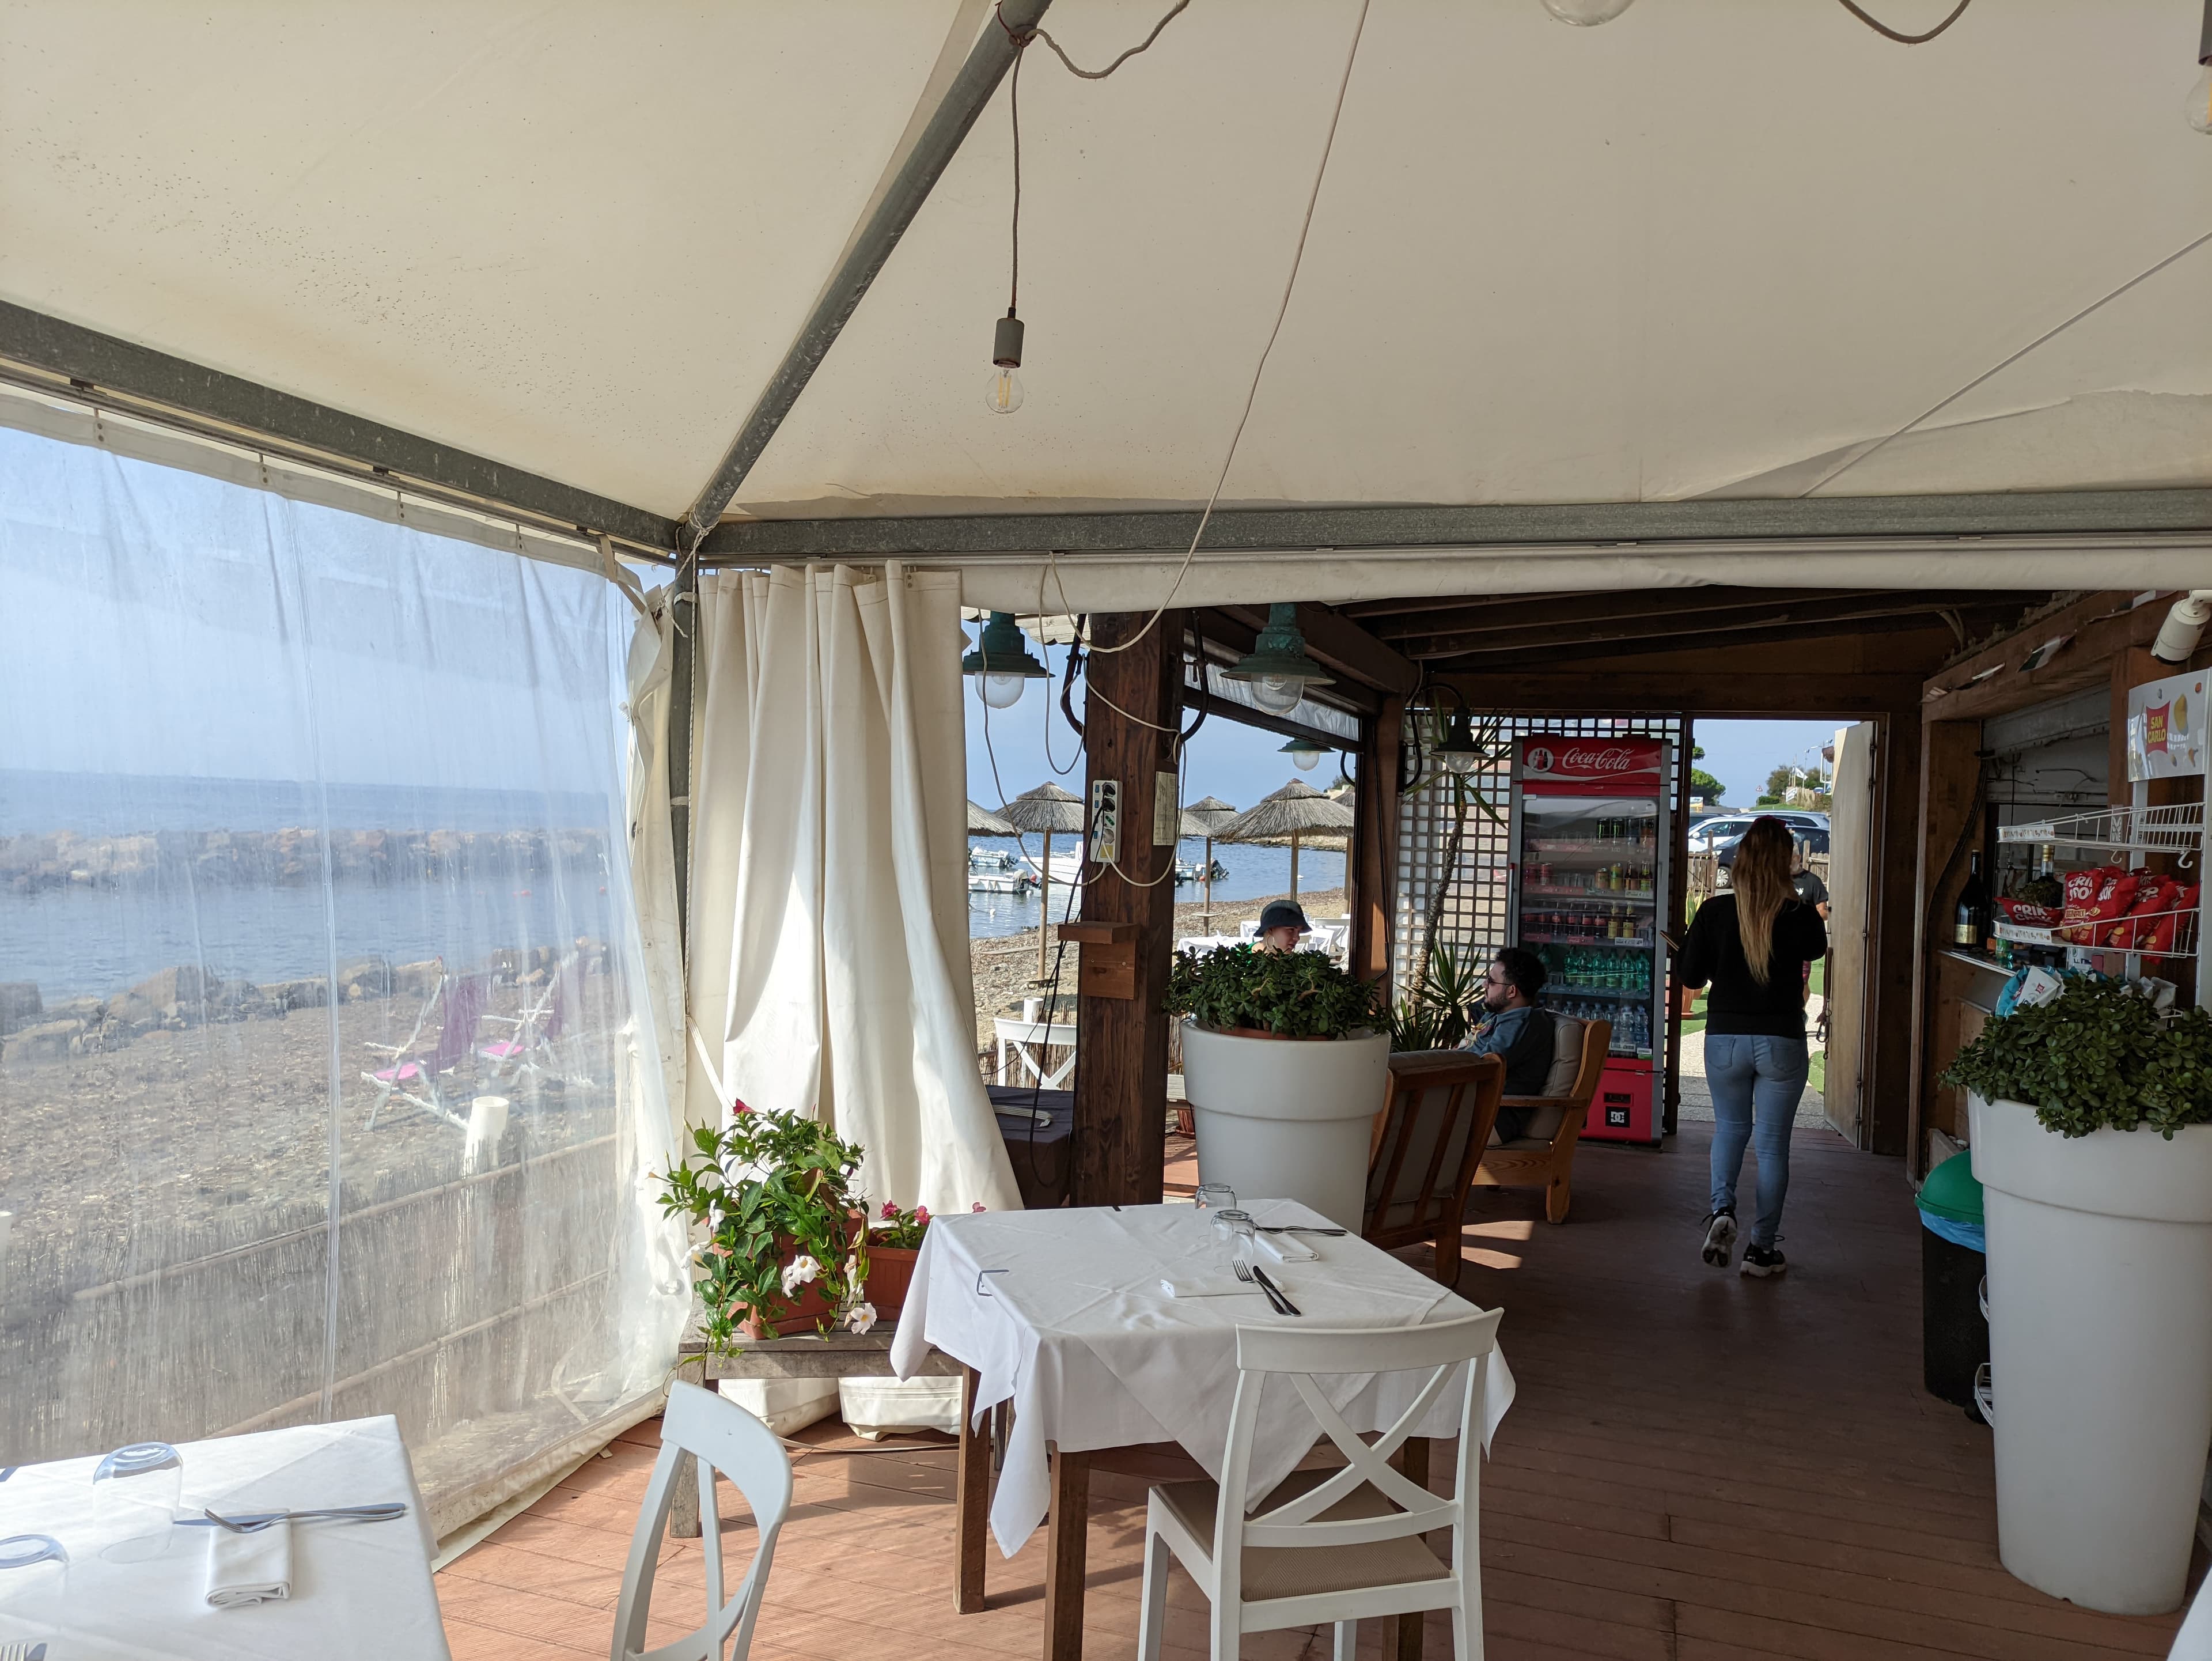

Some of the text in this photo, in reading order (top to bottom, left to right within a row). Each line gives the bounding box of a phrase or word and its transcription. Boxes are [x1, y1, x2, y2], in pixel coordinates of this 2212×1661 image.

[2151, 715, 2163, 729] SAN
[2148, 728, 2166, 743] CARLO
[1562, 748, 1635, 770] Coca-Cola
